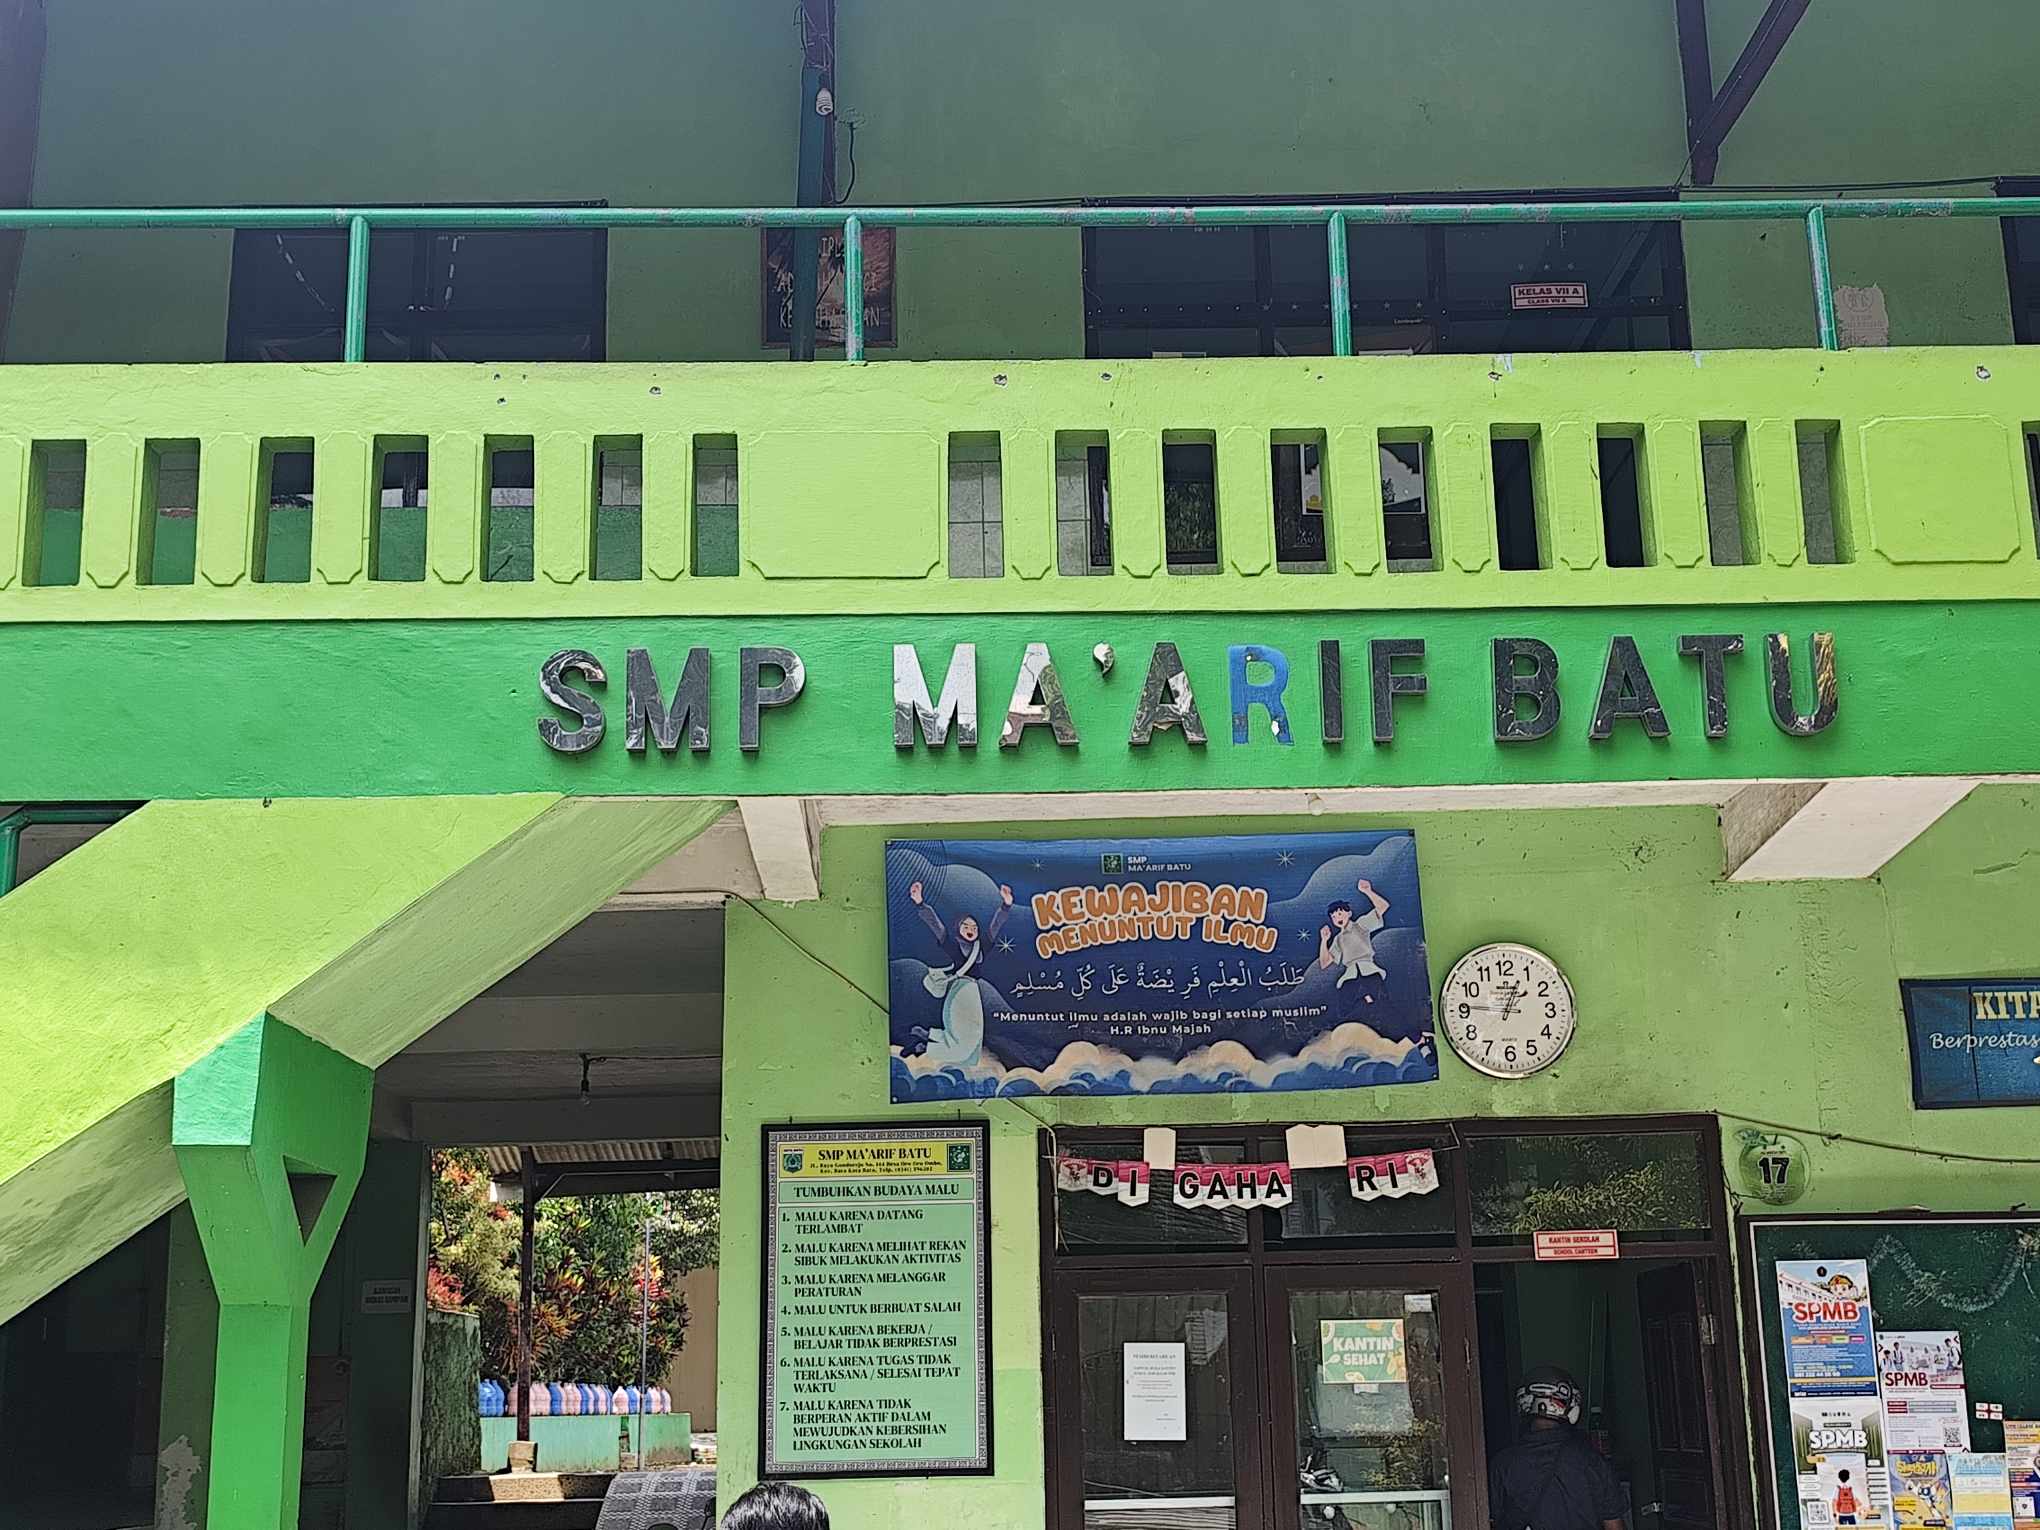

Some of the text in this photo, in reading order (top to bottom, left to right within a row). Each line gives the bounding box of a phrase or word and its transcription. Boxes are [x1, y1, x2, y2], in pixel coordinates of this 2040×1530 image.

[1518, 288, 1552, 296] KELAS
[537, 632, 1840, 753] SMP MA'ARIF BATU
[1032, 881, 1268, 929] KEWAJIBAN
[1036, 915, 1278, 959] MENUNTUT ILMU
[1477, 966, 1490, 982] 11
[1496, 960, 1514, 976] 12
[1523, 966, 1530, 981] 1
[1462, 982, 1479, 998] 10
[1538, 981, 1549, 996] 2
[1069, 1012, 1098, 1021] ilmu
[1103, 1012, 1147, 1021] adalah
[1152, 1011, 1188, 1021] wajib
[1193, 1010, 1221, 1021] bagi
[1226, 1009, 1267, 1020] setiap
[1459, 1003, 1470, 1018] 9
[1545, 1002, 1556, 1018] 3
[1110, 1024, 1211, 1035] H.R Ibnu Majah
[1466, 1025, 1477, 1040] 8
[1541, 1024, 1552, 1039] 4
[1482, 1040, 1493, 1056] 7
[1505, 1046, 1516, 1062] 6
[1526, 1040, 1537, 1055] 5
[819, 1148, 932, 1161] SMP MA'ARIF BATU
[1759, 1157, 1790, 1184] 17
[793, 1184, 959, 1198] TUMBUHKAN BUDAYA MALU
[782, 1209, 923, 1222] 1. MALU KARENA DATANG
[795, 1224, 863, 1234] TERLAMBAT
[781, 1240, 966, 1253] 2. MALU KARENA MELIHAT REKAN
[794, 1253, 961, 1265] SIBUK MELAKUKAN AKTIVITAS
[781, 1272, 946, 1284] 3. MALU KARENA MELANGGAR
[794, 1286, 862, 1297] PERATURAN
[781, 1302, 961, 1315] 4. MALU UNTUK BERBUAT SALAH
[1793, 1301, 1860, 1322] SPMB
[781, 1324, 933, 1336] 5. MALU KARENA BEKERJA /
[794, 1336, 957, 1350] BELAJAR TIDAK BERPRESTASI
[1332, 1336, 1394, 1352] KANTIN
[780, 1354, 951, 1367] 6. MALU KARENA TUGAS TIDAK
[1343, 1352, 1386, 1366] SEHAT
[793, 1367, 960, 1380] TERLAKSANA / SELESAI TEPAT
[1885, 1372, 1928, 1386] SPMB
[793, 1383, 836, 1393] WAKTU
[780, 1399, 911, 1411] 7. MALU KARENA TIDAK
[793, 1411, 931, 1424] BERPERAN AKTIF DALAM
[793, 1424, 947, 1437] MEWUJUDKAN KEBERSIHAN
[793, 1438, 922, 1451] LINGKUNGAN SEKOLAH
[1809, 1430, 1868, 1449] SPMB
